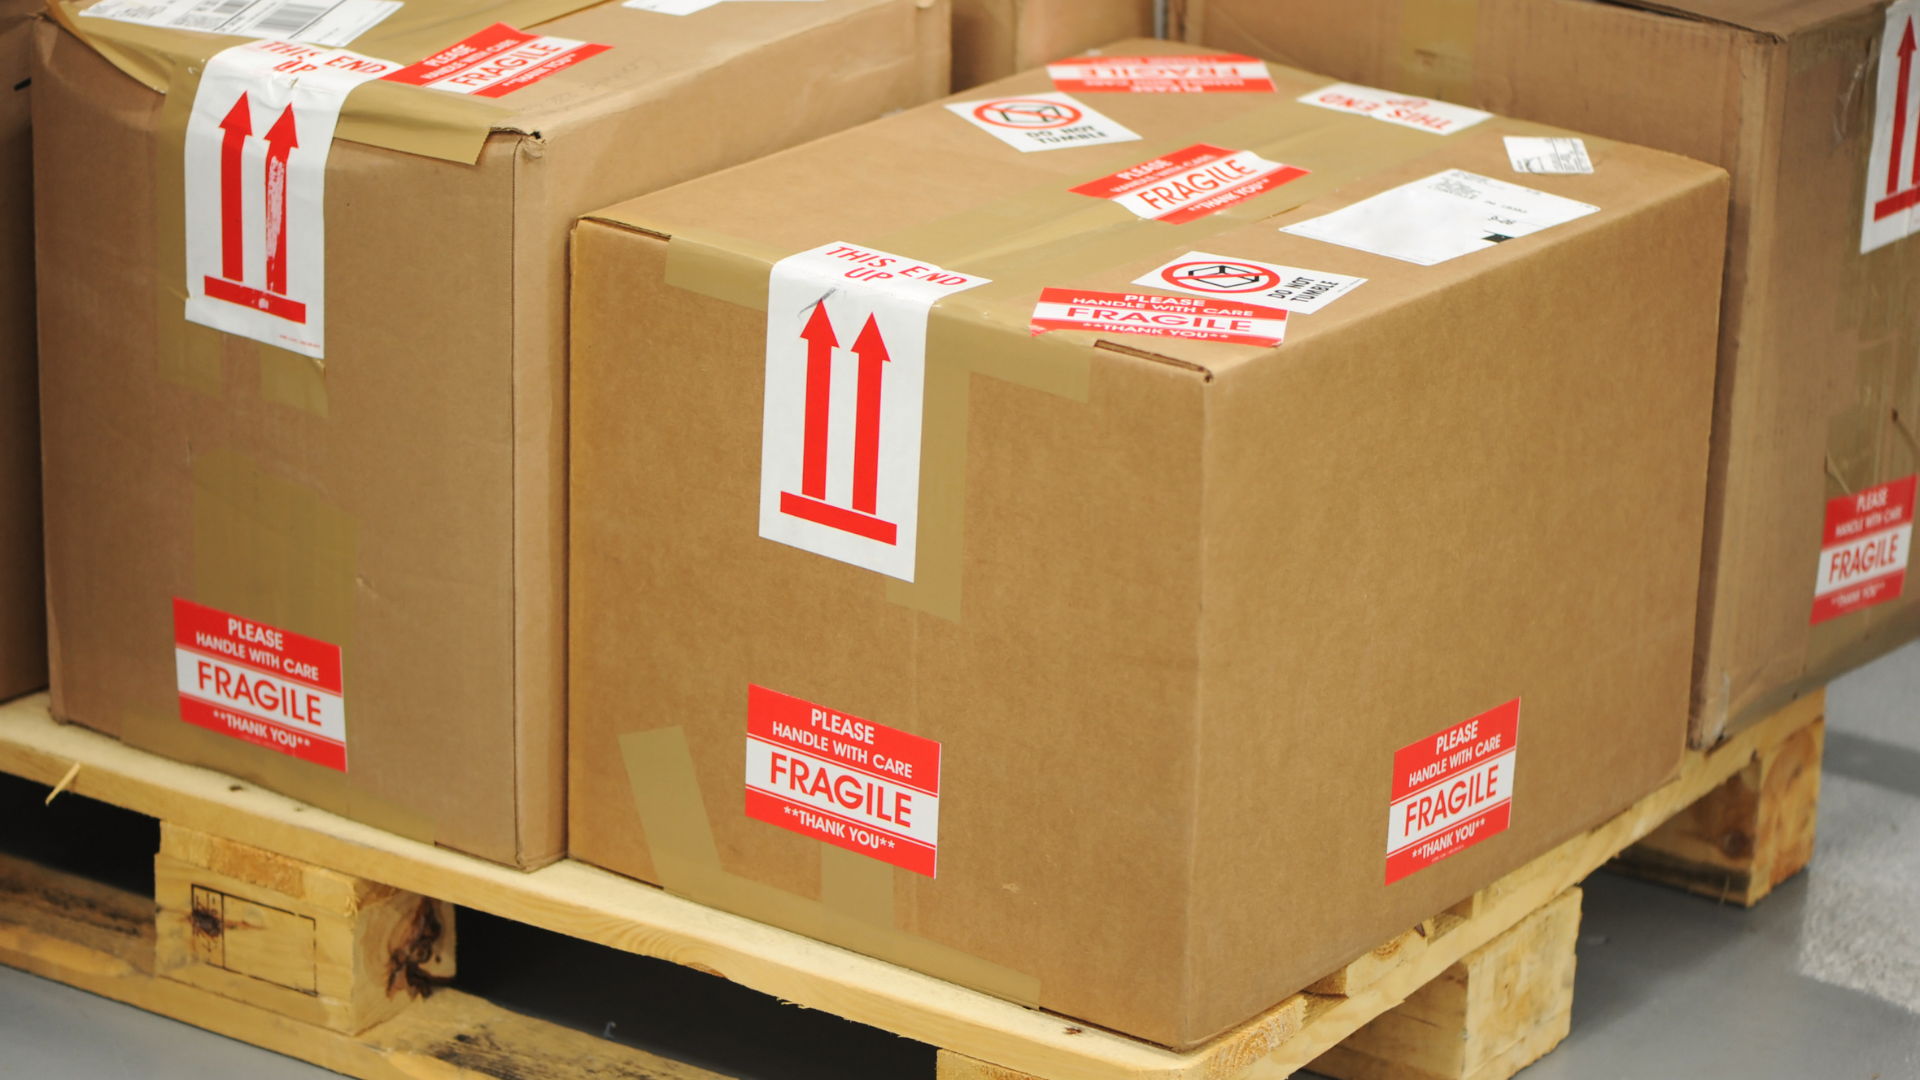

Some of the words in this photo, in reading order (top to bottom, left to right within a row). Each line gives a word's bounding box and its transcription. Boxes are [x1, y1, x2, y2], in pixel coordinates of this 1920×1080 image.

[260, 41, 323, 60] THIS
[324, 55, 388, 75] END
[273, 60, 318, 75] UP
[423, 44, 477, 67] PLEASE
[448, 42, 563, 86] FRAGILE
[1037, 132, 1109, 144] TUMBLE
[1116, 159, 1173, 181] PLEASE
[1137, 159, 1257, 210] FRAGILE
[825, 246, 897, 267] THIS
[898, 265, 968, 286] END
[844, 267, 894, 281] UP
[1124, 294, 1206, 307] PLEASE
[1266, 289, 1293, 299] DO
[1284, 276, 1315, 289] NOT
[1289, 280, 1339, 302] TUMBLE
[1067, 307, 1252, 332] FRAGILE
[1072, 297, 1146, 309] HANDLE
[1152, 304, 1196, 314] WITH
[1203, 307, 1254, 317] CARE
[1828, 533, 1899, 584] FRAGILE
[228, 618, 283, 651] PLEASE
[196, 631, 246, 659] HANDLE
[248, 647, 280, 669] WITH
[283, 658, 319, 681] CARE
[198, 660, 322, 727] FRAGILE
[811, 708, 875, 745] PLEASE
[1436, 720, 1479, 755] PLEASE
[772, 721, 829, 752] HANDLE
[832, 740, 868, 764] WITH
[873, 754, 913, 779] CARE
[1408, 758, 1447, 788] HANDLE
[1449, 746, 1473, 769] WITH
[1475, 734, 1501, 757] CARE
[770, 751, 912, 829] FRAGILE
[1404, 763, 1499, 837] FRAGILE
